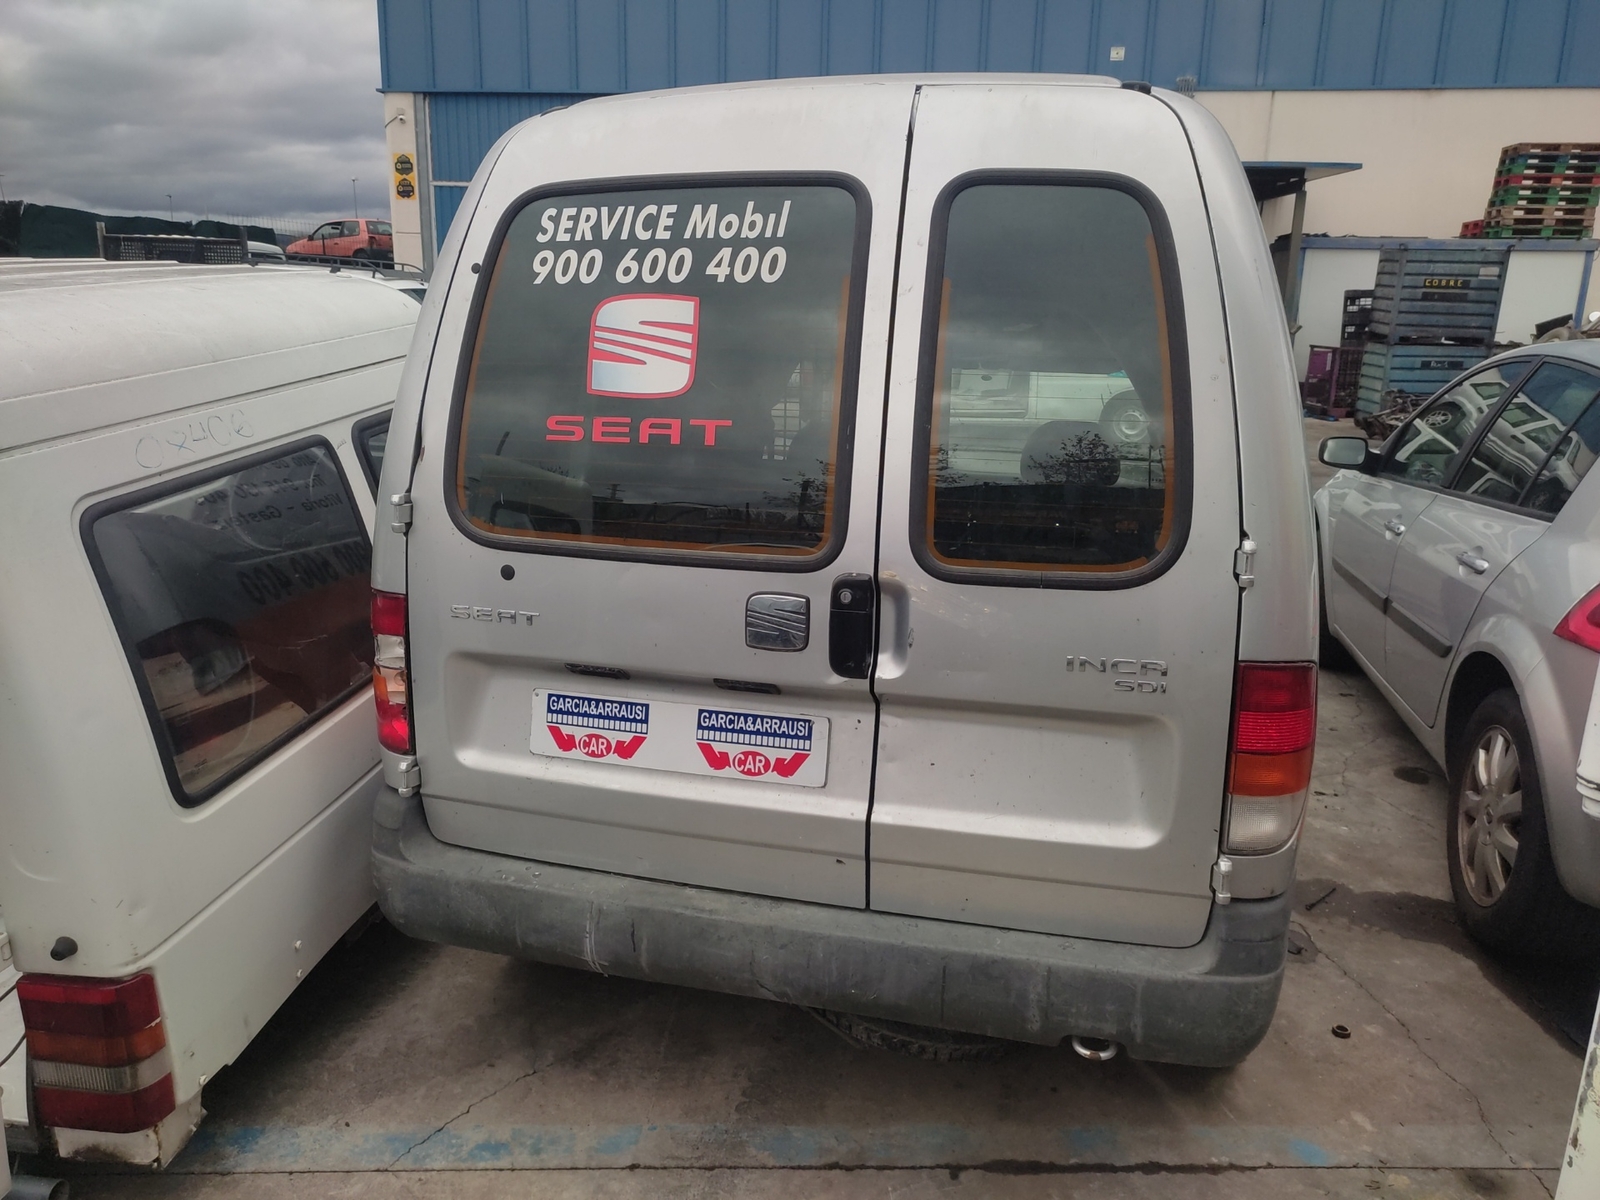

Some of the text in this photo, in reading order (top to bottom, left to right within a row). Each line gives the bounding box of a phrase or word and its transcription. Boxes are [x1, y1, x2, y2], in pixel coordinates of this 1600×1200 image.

[535, 204, 678, 243] SERVICE
[532, 246, 787, 285] 900 600 400
[1425, 279, 1463, 287] COBRE
[545, 415, 733, 446] SEAT
[450, 604, 540, 626] SEAT
[1066, 655, 1168, 676] INCA
[1114, 679, 1167, 694] SDI
[549, 696, 647, 720] GARCIA&ARRAUSI
[700, 712, 810, 737] GARCIA&ARRAUSI
[579, 736, 608, 756] CAR
[734, 753, 766, 774] CAR
